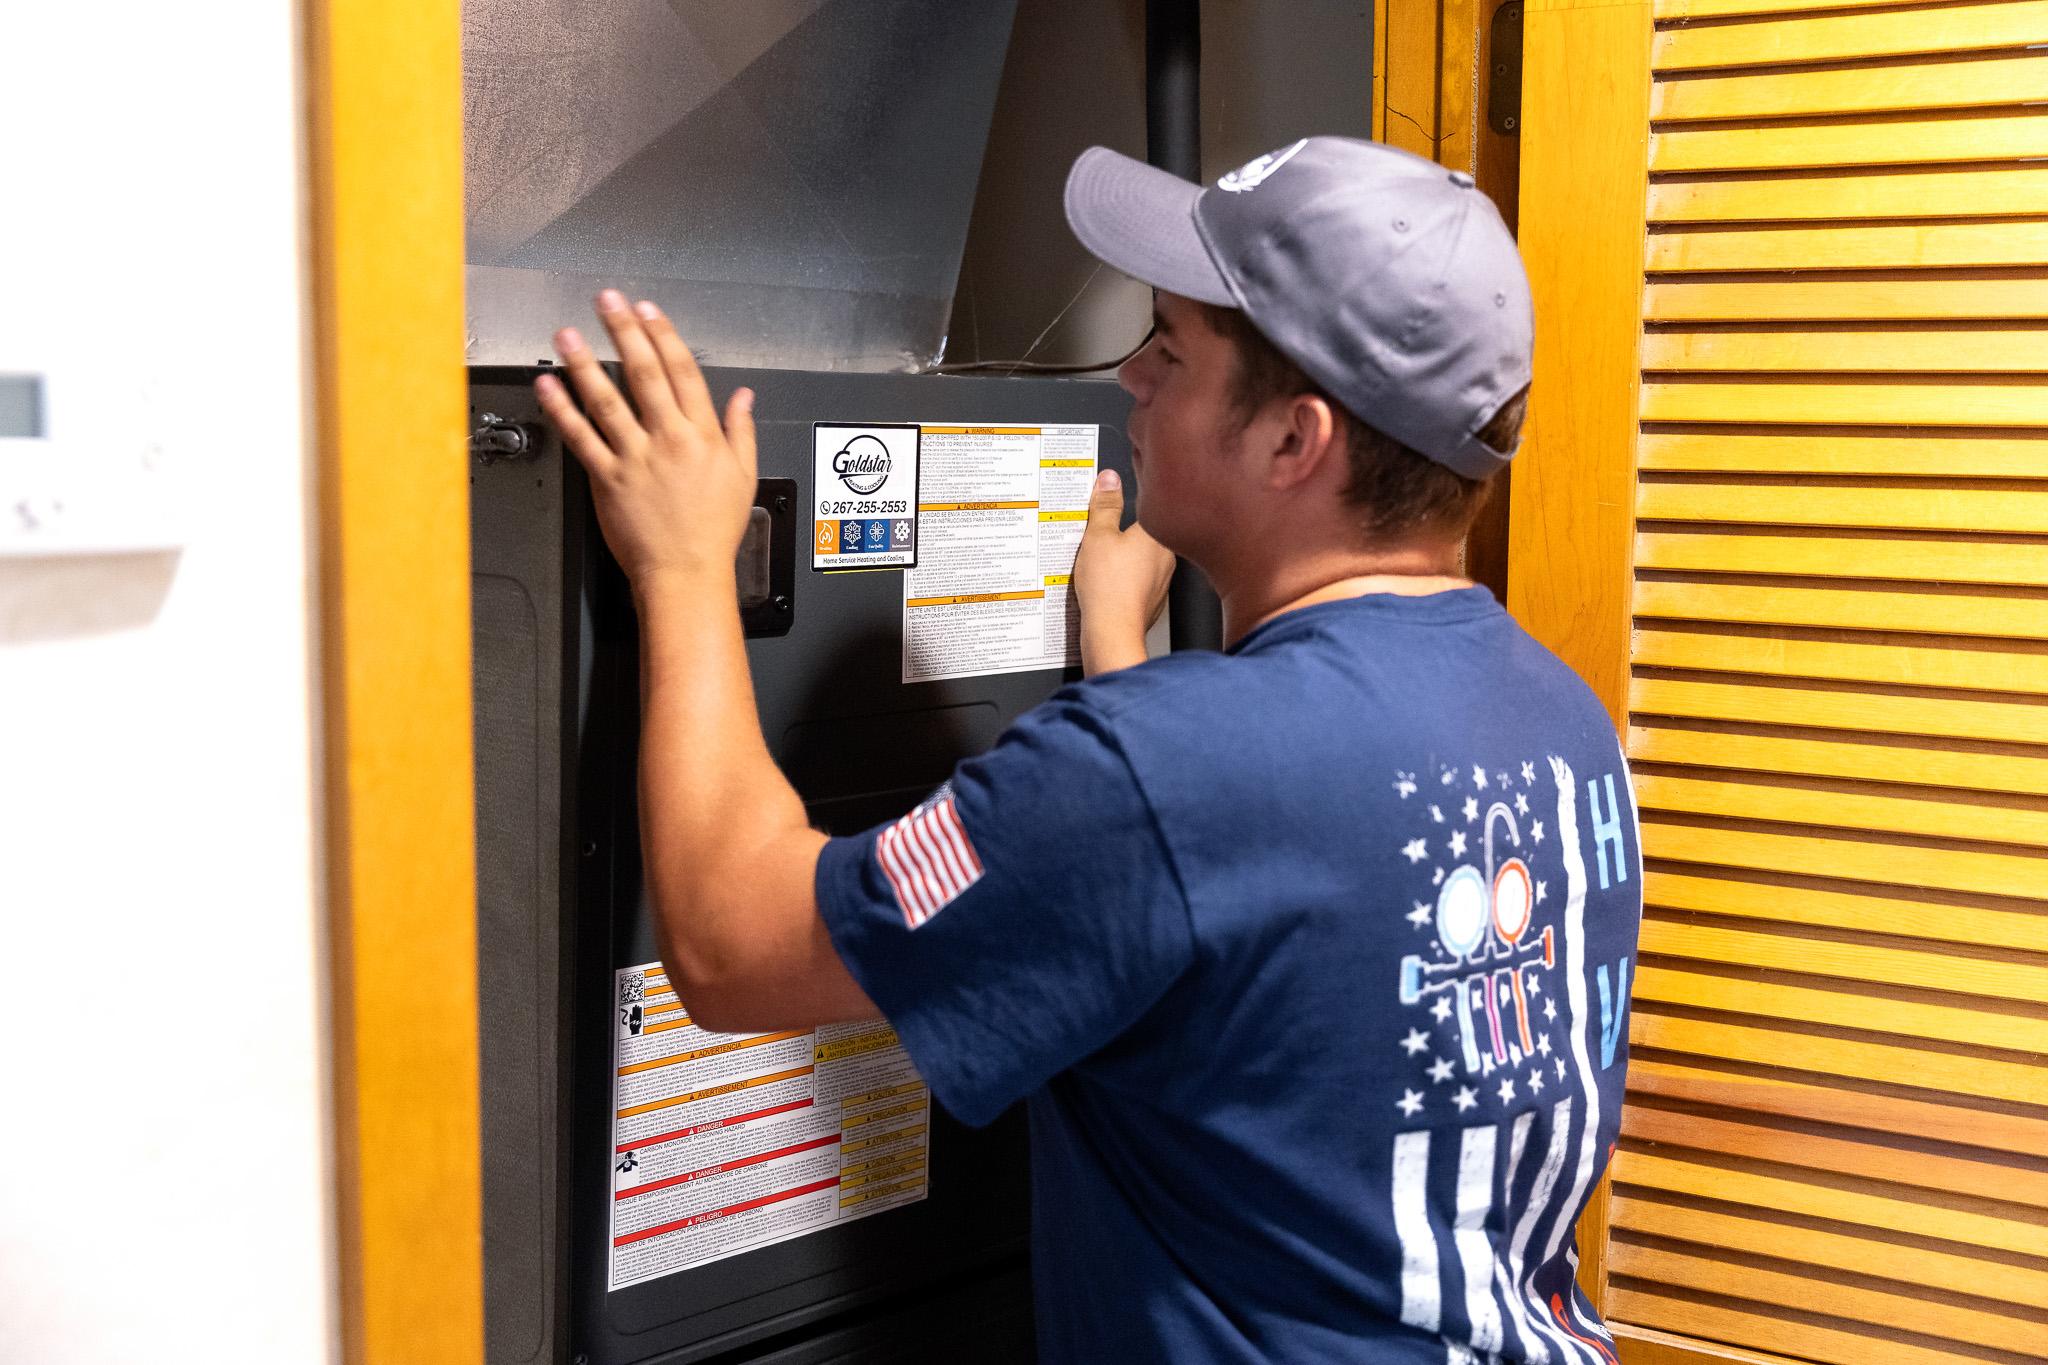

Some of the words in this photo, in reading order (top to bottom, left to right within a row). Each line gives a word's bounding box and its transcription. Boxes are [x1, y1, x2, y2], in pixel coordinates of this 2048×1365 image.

[833, 450, 893, 473] Goldstar
[847, 477, 863, 490] HEATING
[868, 475, 884, 490] COOLING
[832, 501, 907, 514] 267-255-2553
[1588, 773, 1626, 890] H
[1596, 956, 1628, 1070] V
[698, 1043, 741, 1057] ADVERTENCIA
[697, 1082, 749, 1098] AVERTISSEMENT
[697, 1121, 724, 1133] DANGER
[639, 1144, 663, 1155] CARBON
[664, 1137, 693, 1149] MONOXIDE
[693, 1130, 723, 1142] POISONING
[724, 1123, 746, 1135] HAZARD
[695, 1166, 723, 1178] DANGER
[616, 1197, 638, 1207] RISQUE
[638, 1182, 695, 1202] D'EMPOISONNEMENT
[704, 1171, 734, 1184] MONOXYDE
[742, 1162, 768, 1173] CARBONE
[695, 1211, 723, 1223] PELIGRO
[616, 1242, 637, 1253] RIESGO
[687, 1224, 699, 1233] POR
[738, 1207, 764, 1219] CARBONO
